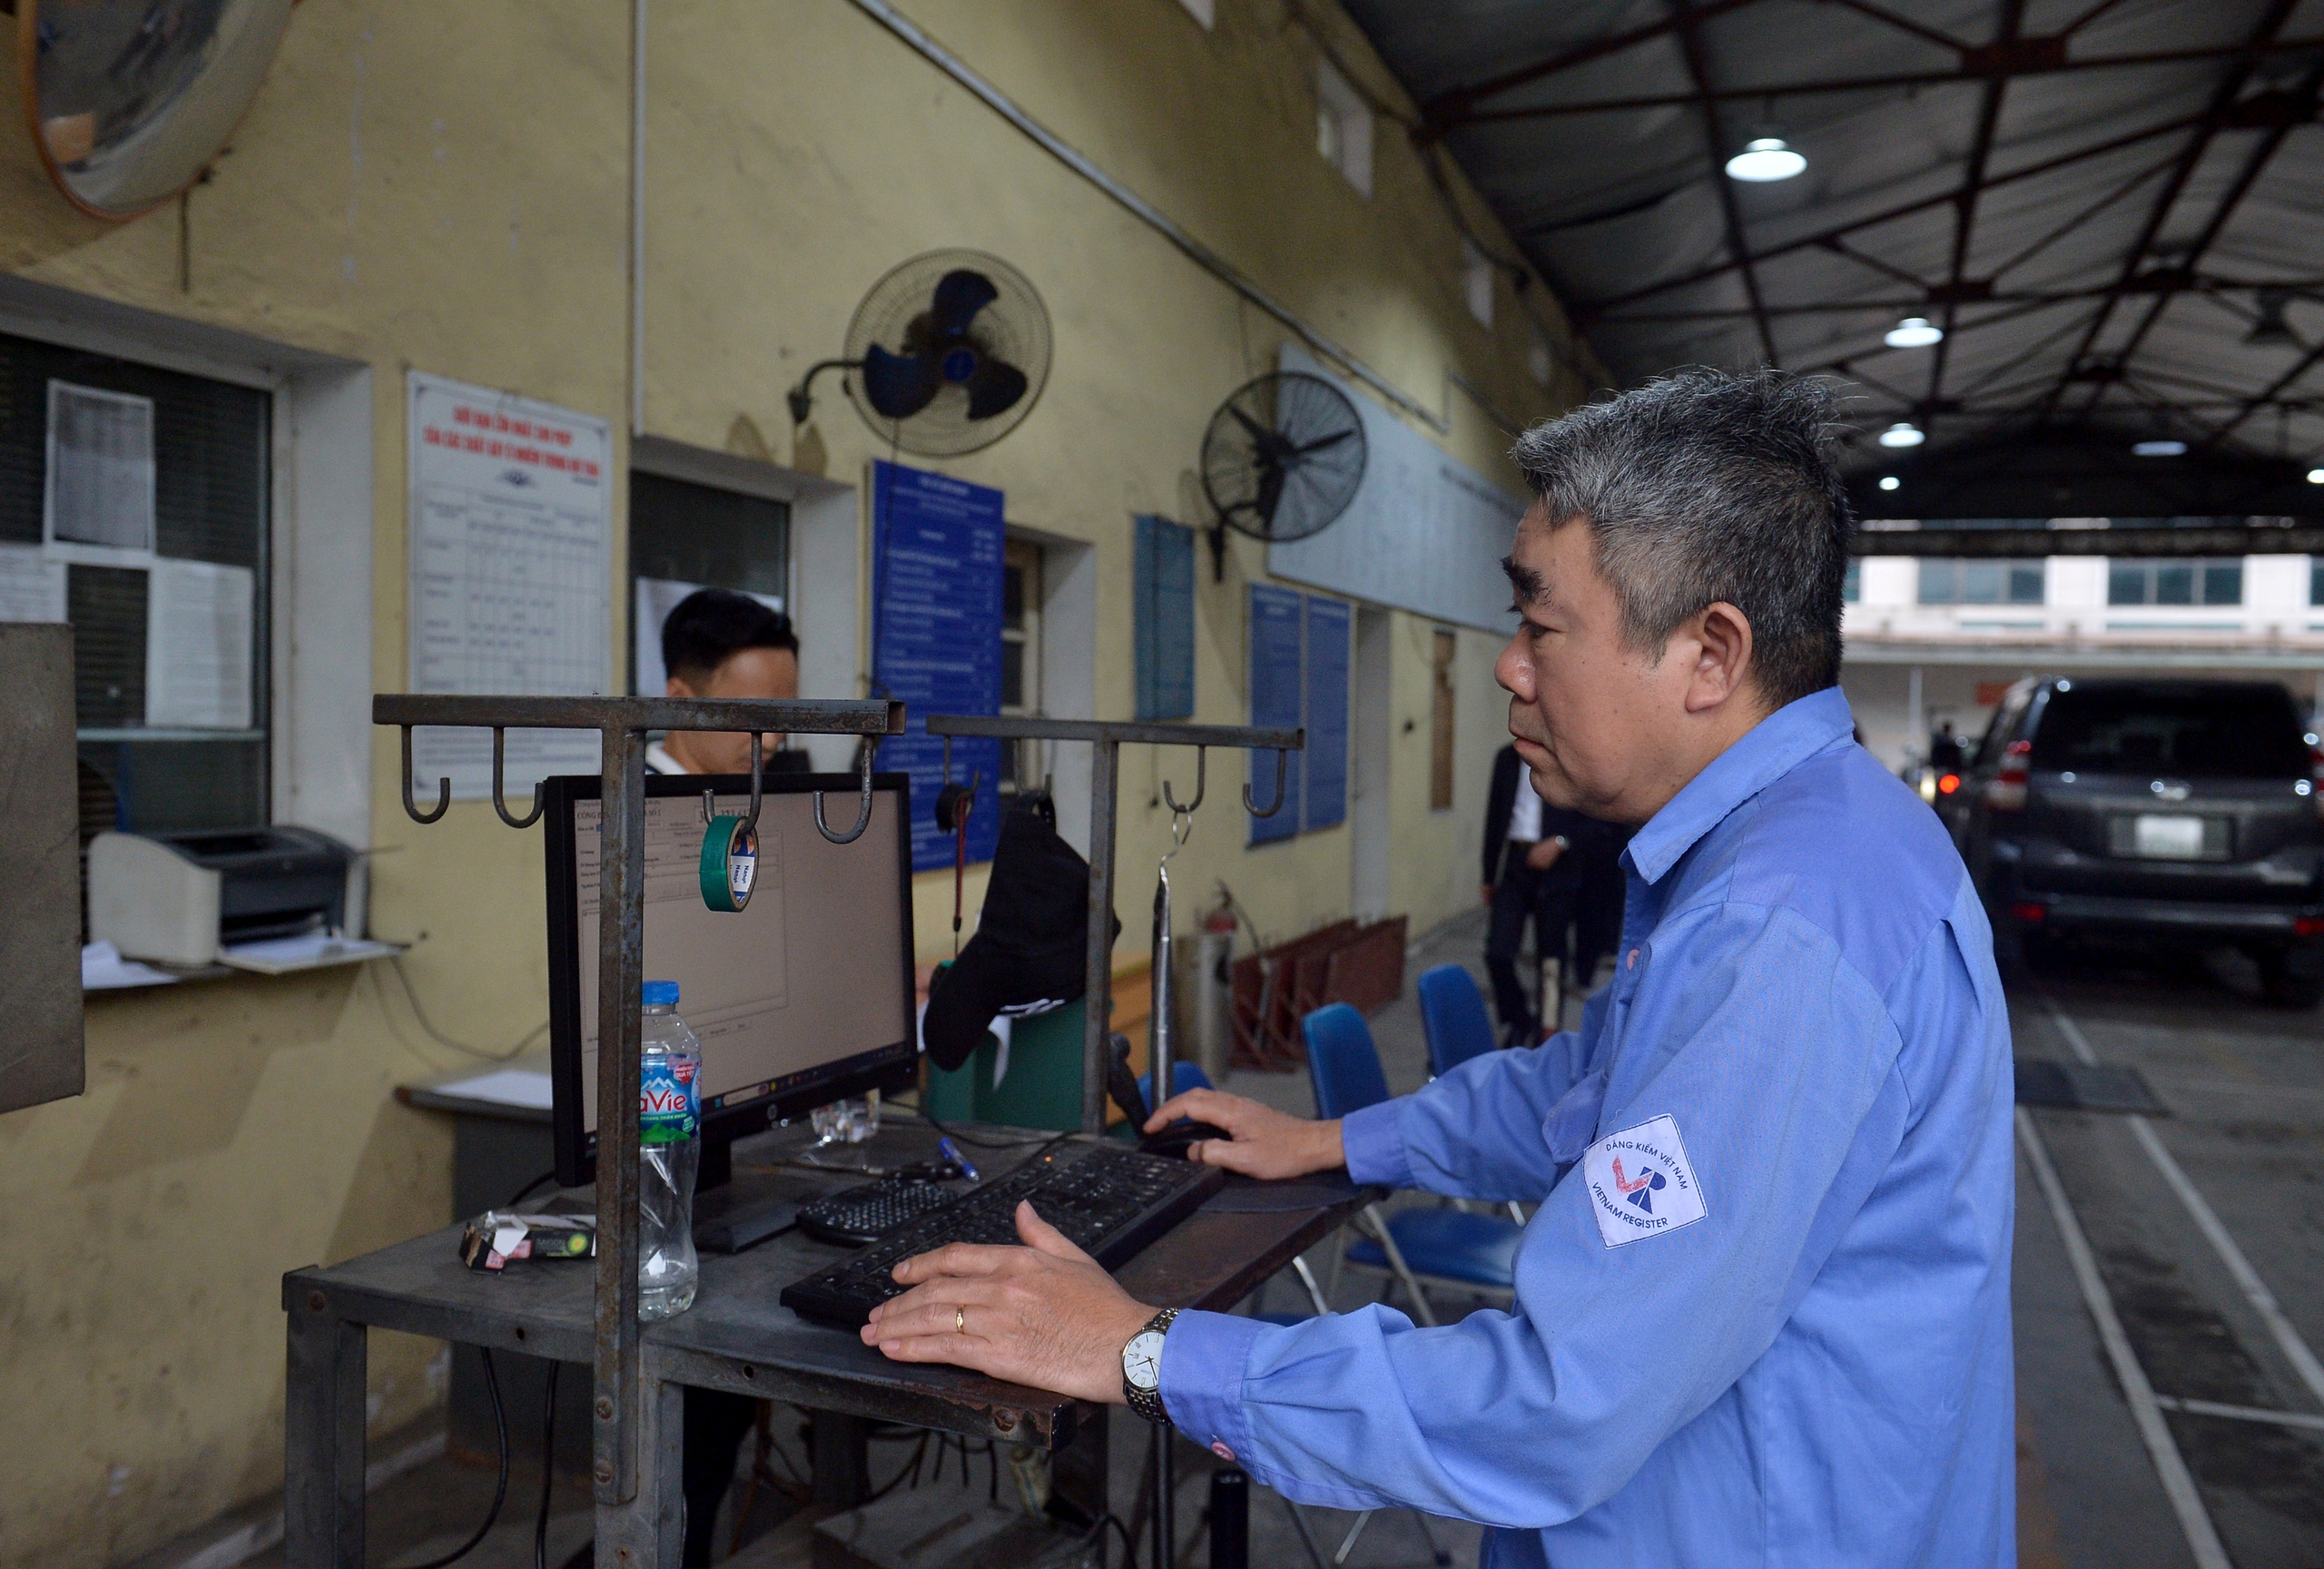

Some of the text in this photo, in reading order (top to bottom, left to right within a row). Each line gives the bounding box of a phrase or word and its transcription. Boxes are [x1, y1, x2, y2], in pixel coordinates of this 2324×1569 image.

[641, 1089, 686, 1113] aVie
[1635, 1142, 1659, 1157] KIỂM
[1659, 1152, 1676, 1168] VIỆT
[1672, 1166, 1688, 1189] NAM
[1592, 1181, 1669, 1229] VIETNAM REGISTER
